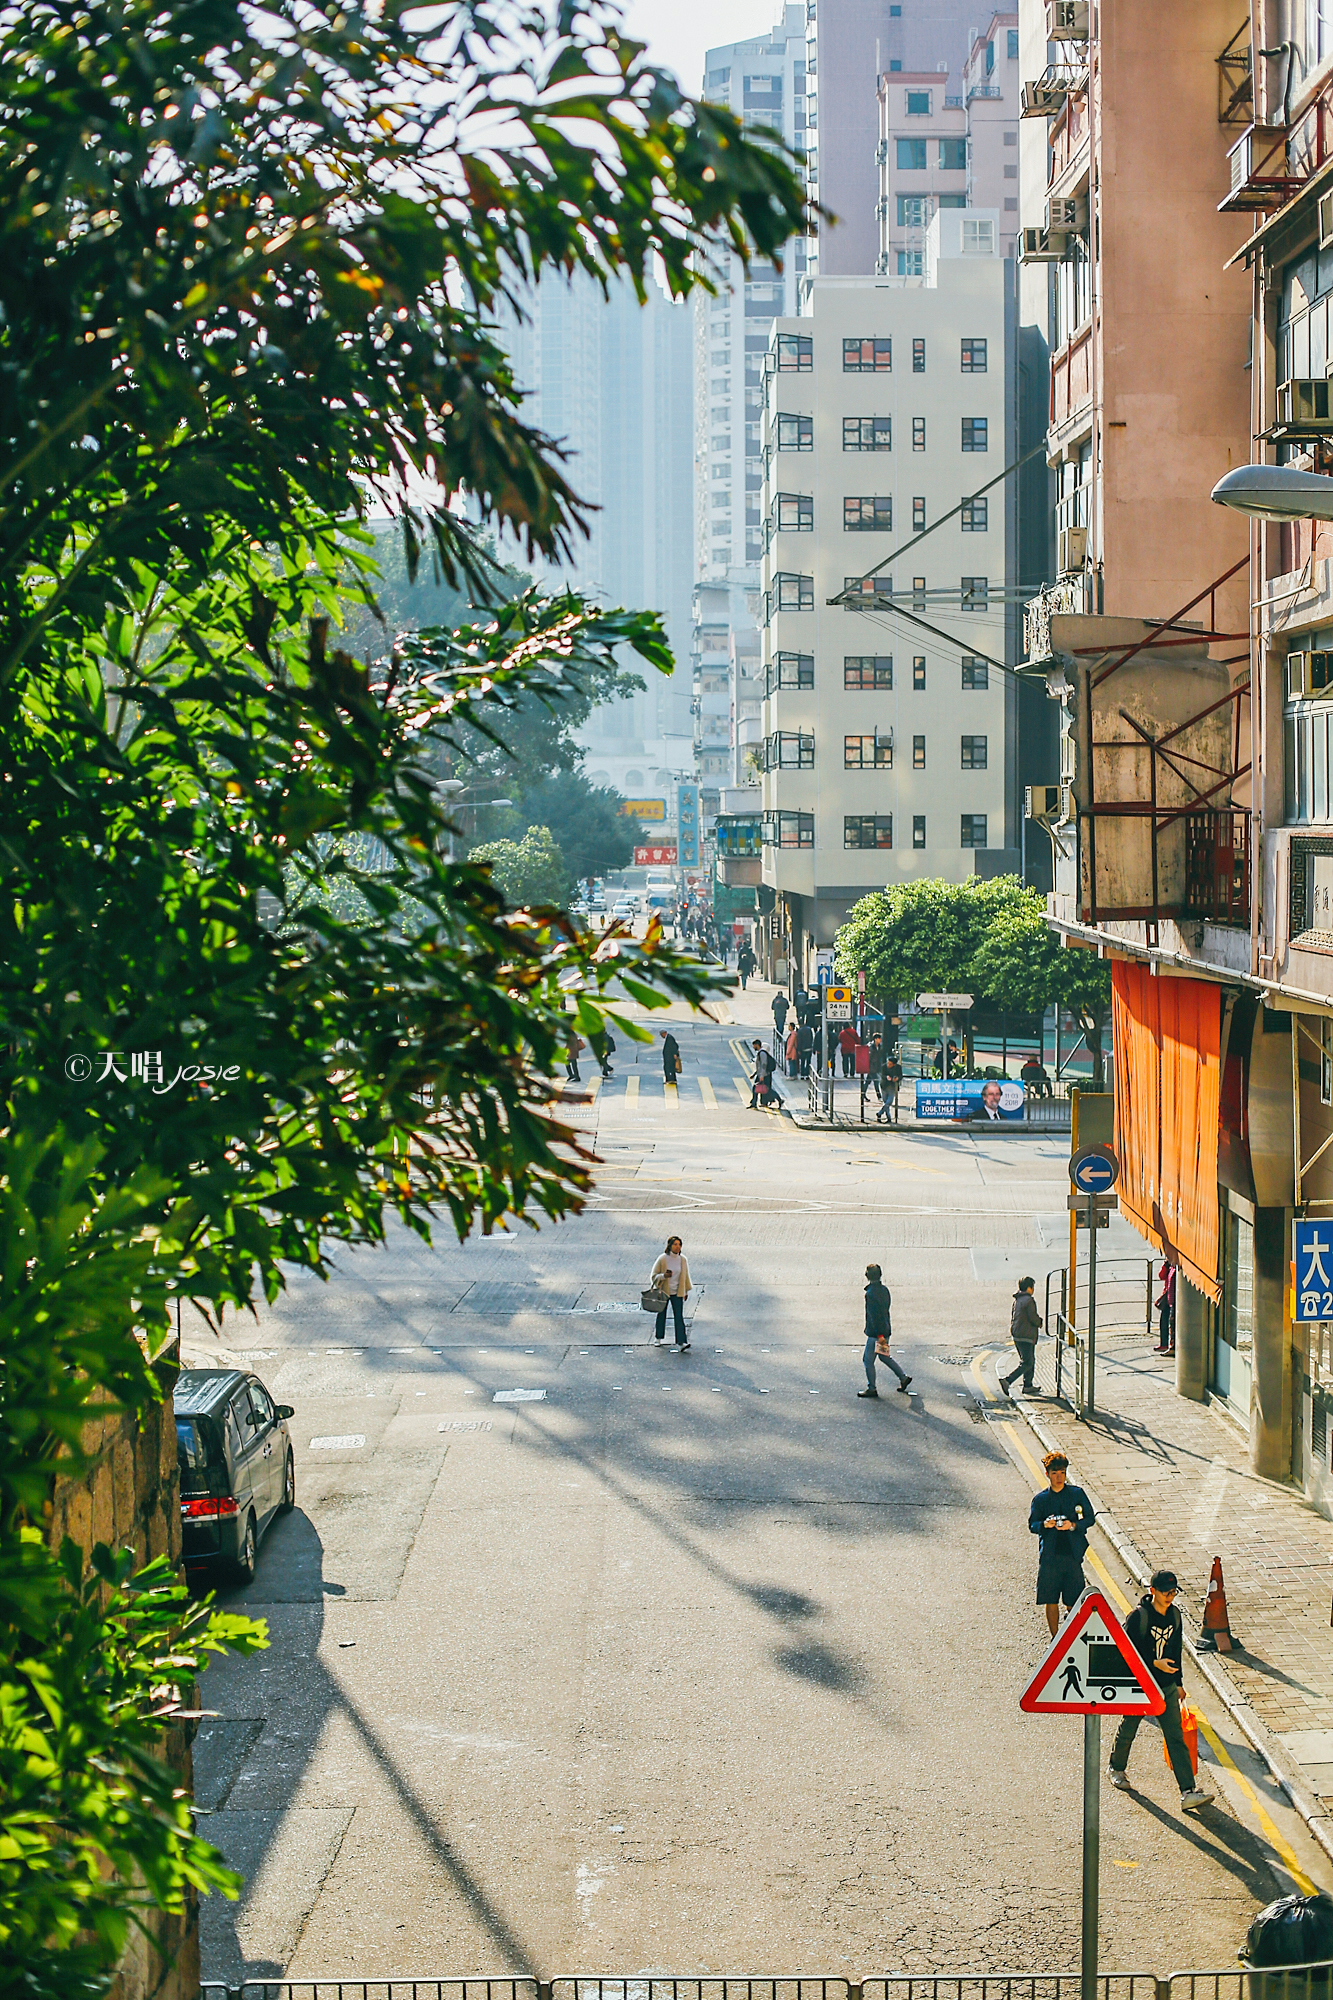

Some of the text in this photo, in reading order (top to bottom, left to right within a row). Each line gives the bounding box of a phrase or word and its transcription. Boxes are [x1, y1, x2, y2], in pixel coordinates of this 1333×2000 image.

[831, 1009, 847, 1017] 全日
[920, 1082, 952, 1094] 司馬文
[921, 1105, 955, 1113] TOGETHER
[1301, 1230, 1331, 1289] 大
